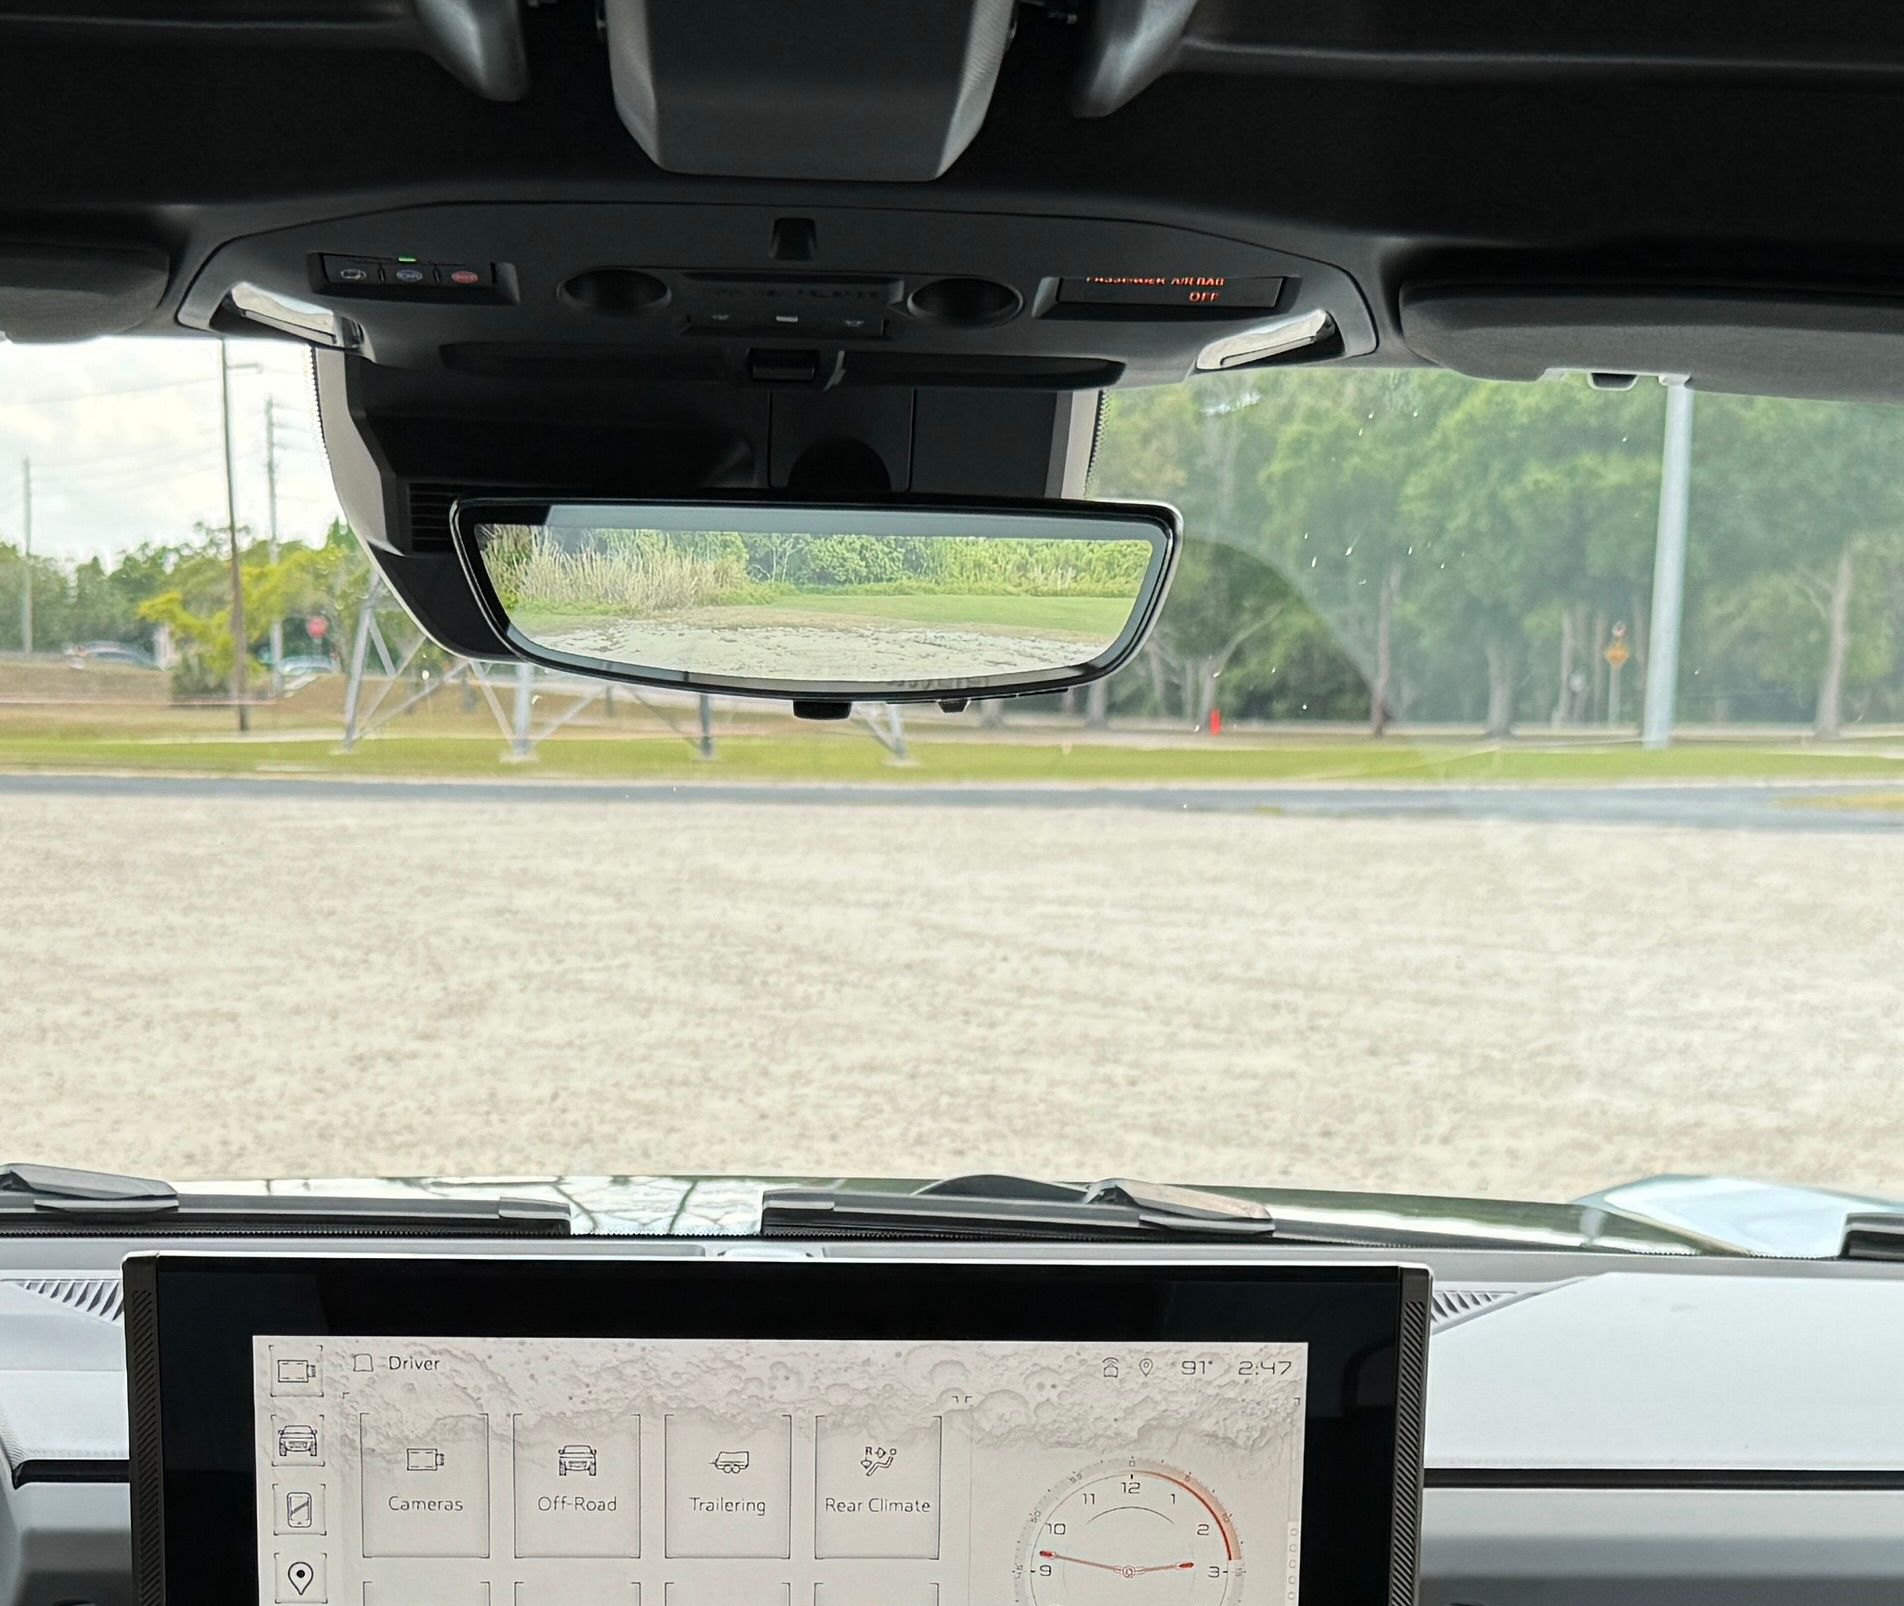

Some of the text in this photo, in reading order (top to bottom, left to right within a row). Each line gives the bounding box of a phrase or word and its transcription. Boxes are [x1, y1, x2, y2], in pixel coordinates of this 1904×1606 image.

[387, 1354, 441, 1372] Driver
[1237, 1360, 1293, 1376] 2:47
[1120, 1481, 1141, 1495] 12
[388, 1495, 464, 1513] Cameras
[537, 1495, 618, 1513] Off-Road
[689, 1496, 767, 1516] Trailering
[824, 1496, 931, 1514] Rear Climate
[1082, 1493, 1096, 1505] 11
[1169, 1493, 1176, 1505] 1
[1046, 1523, 1066, 1536] 10
[1196, 1523, 1210, 1536] 2
[1039, 1564, 1052, 1577] 9
[1208, 1565, 1220, 1578] 3
